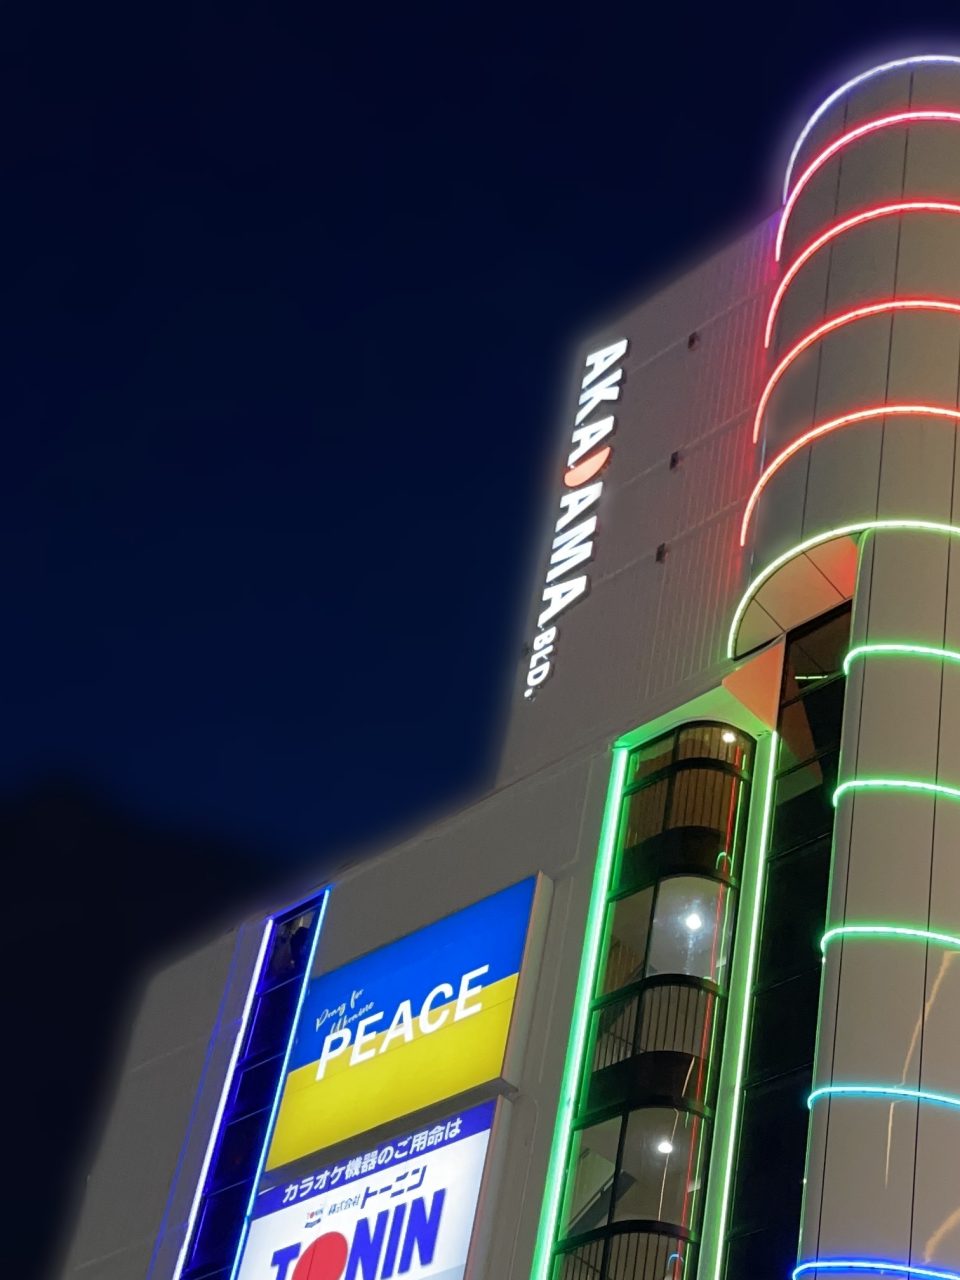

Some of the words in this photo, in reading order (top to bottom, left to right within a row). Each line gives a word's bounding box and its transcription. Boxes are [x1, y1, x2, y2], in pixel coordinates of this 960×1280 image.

[315, 965, 490, 1081] PEACE
[282, 1117, 463, 1203] カラオケ機器のご用命は
